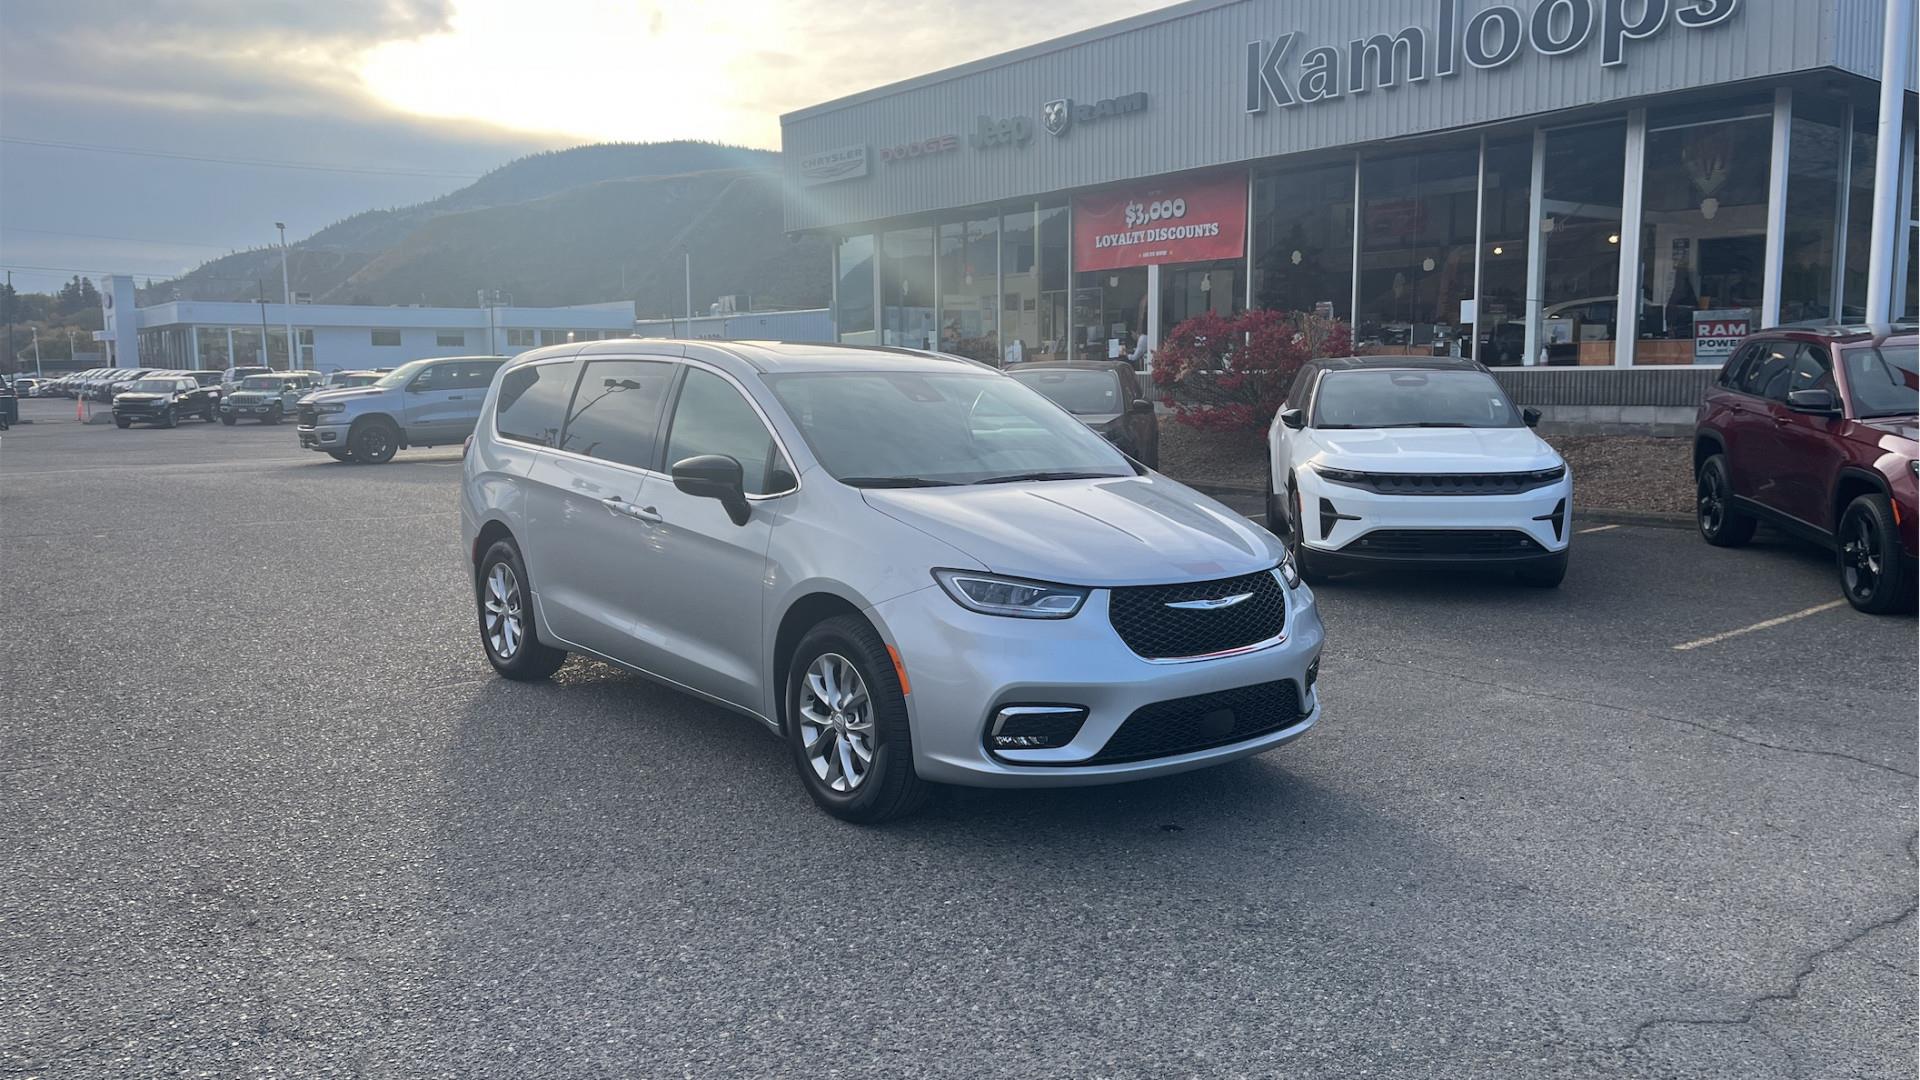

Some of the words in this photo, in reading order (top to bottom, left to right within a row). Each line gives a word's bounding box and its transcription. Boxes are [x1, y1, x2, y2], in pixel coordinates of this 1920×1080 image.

[1072, 91, 1148, 123] RAM
[968, 115, 1034, 149] Jeep
[801, 149, 864, 170] CHRYSLER
[879, 134, 960, 163] DODGE
[1125, 198, 1187, 229] $3,000
[1095, 230, 1145, 248] LOYALTY
[1147, 222, 1220, 242] DISCOUNTS
[1698, 323, 1747, 336] RAM
[1698, 339, 1741, 347] POWE
